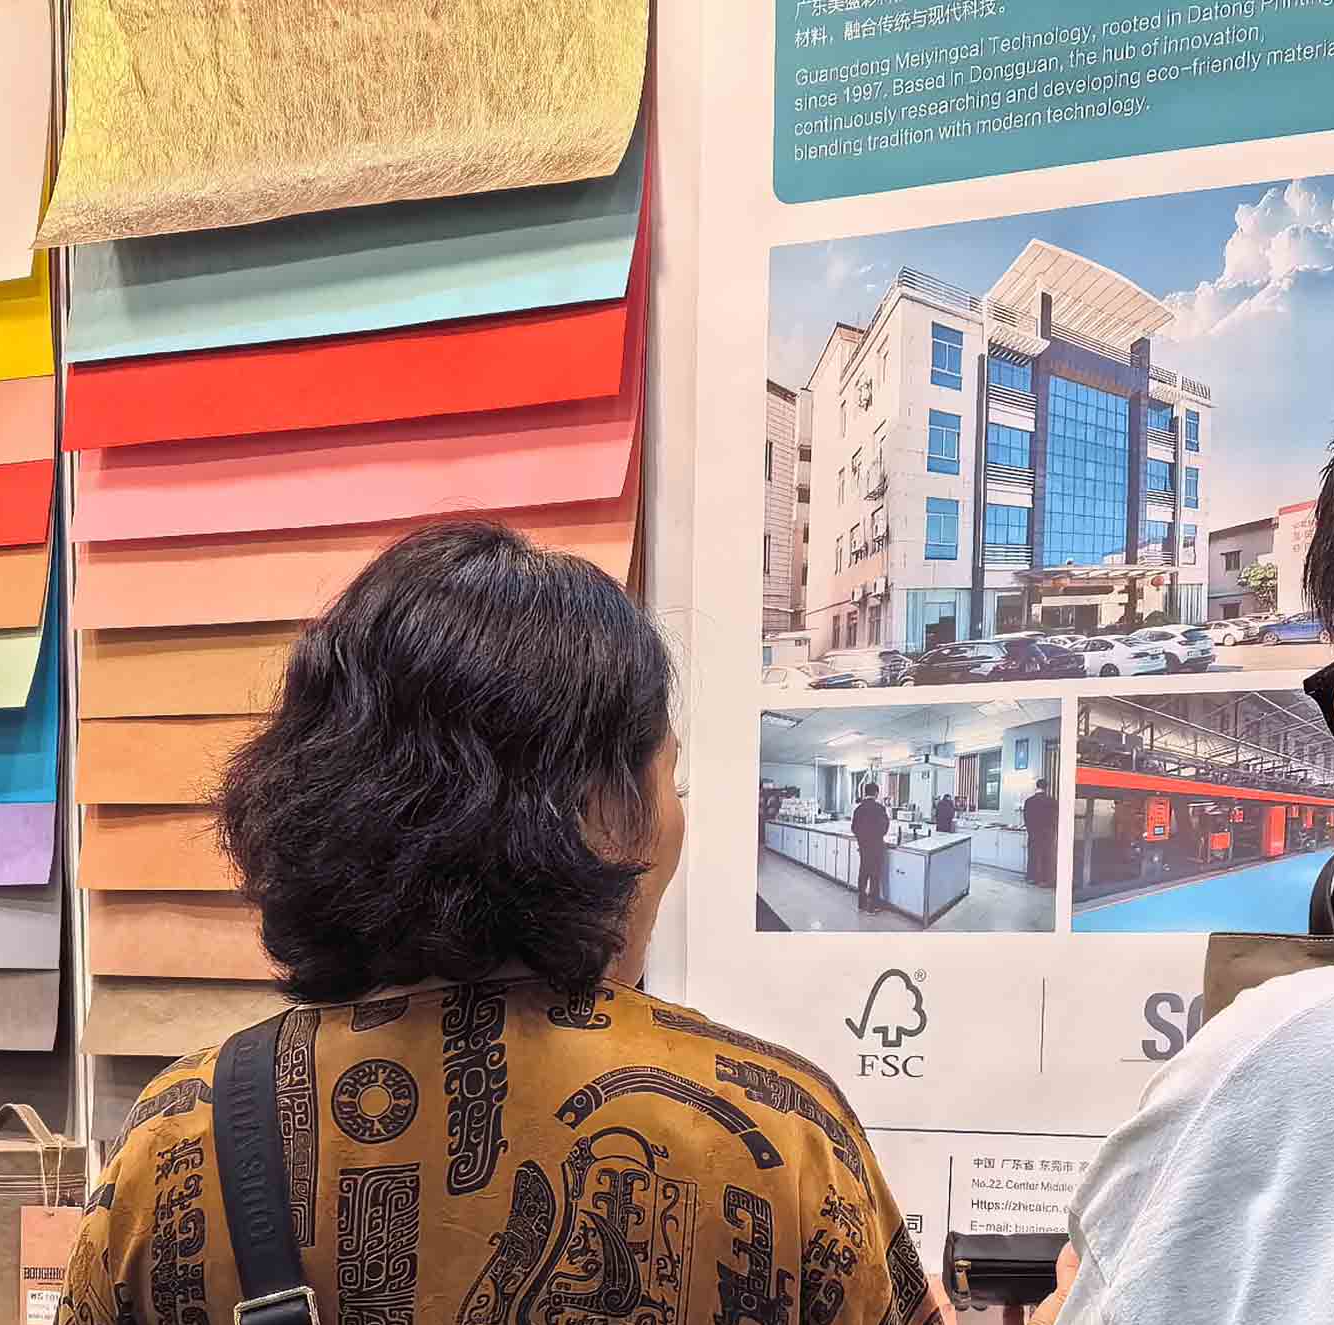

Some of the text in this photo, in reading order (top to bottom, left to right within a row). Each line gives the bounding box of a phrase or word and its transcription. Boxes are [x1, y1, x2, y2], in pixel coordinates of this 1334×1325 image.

[795, 25, 1266, 112] since 1997. Based in Dongguan, the hub of innovation,
[796, 56, 890, 86] Guangdong
[989, 24, 1097, 54] Technology,
[1103, 14, 1161, 35] rooted
[1167, 9, 1181, 27] in
[1187, 0, 1255, 24] Datong
[794, 95, 1150, 162] blending tradition with modern technology.
[795, 108, 896, 137] continuously
[901, 90, 1002, 120] researching
[1006, 84, 1040, 104] and
[1043, 69, 1141, 99] developing
[1146, 50, 1262, 84] eco-friendly
[857, 1053, 924, 1078] FSC
